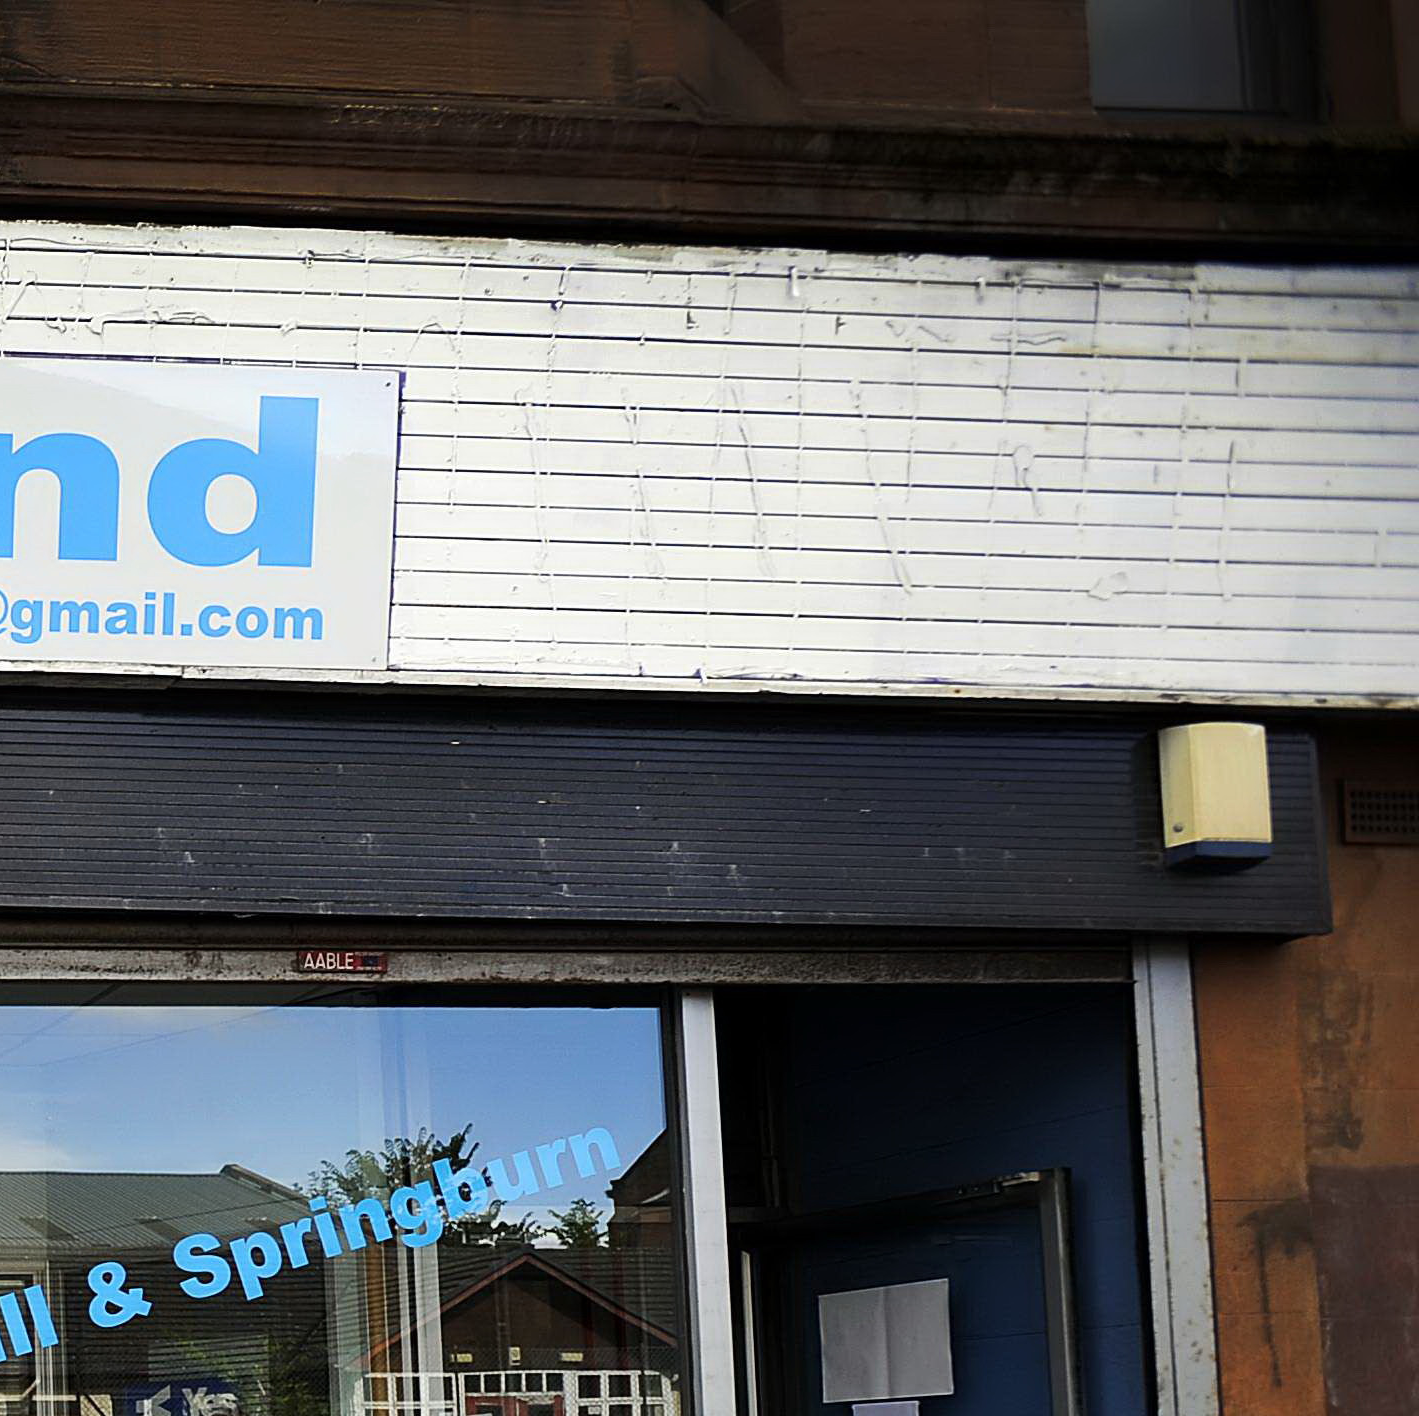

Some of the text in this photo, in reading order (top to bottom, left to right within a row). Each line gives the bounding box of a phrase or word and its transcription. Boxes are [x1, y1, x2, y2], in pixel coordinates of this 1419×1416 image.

[304, 952, 354, 970] AABLE
[87, 1261, 153, 1328] &
[172, 1125, 620, 1300] Springburn
